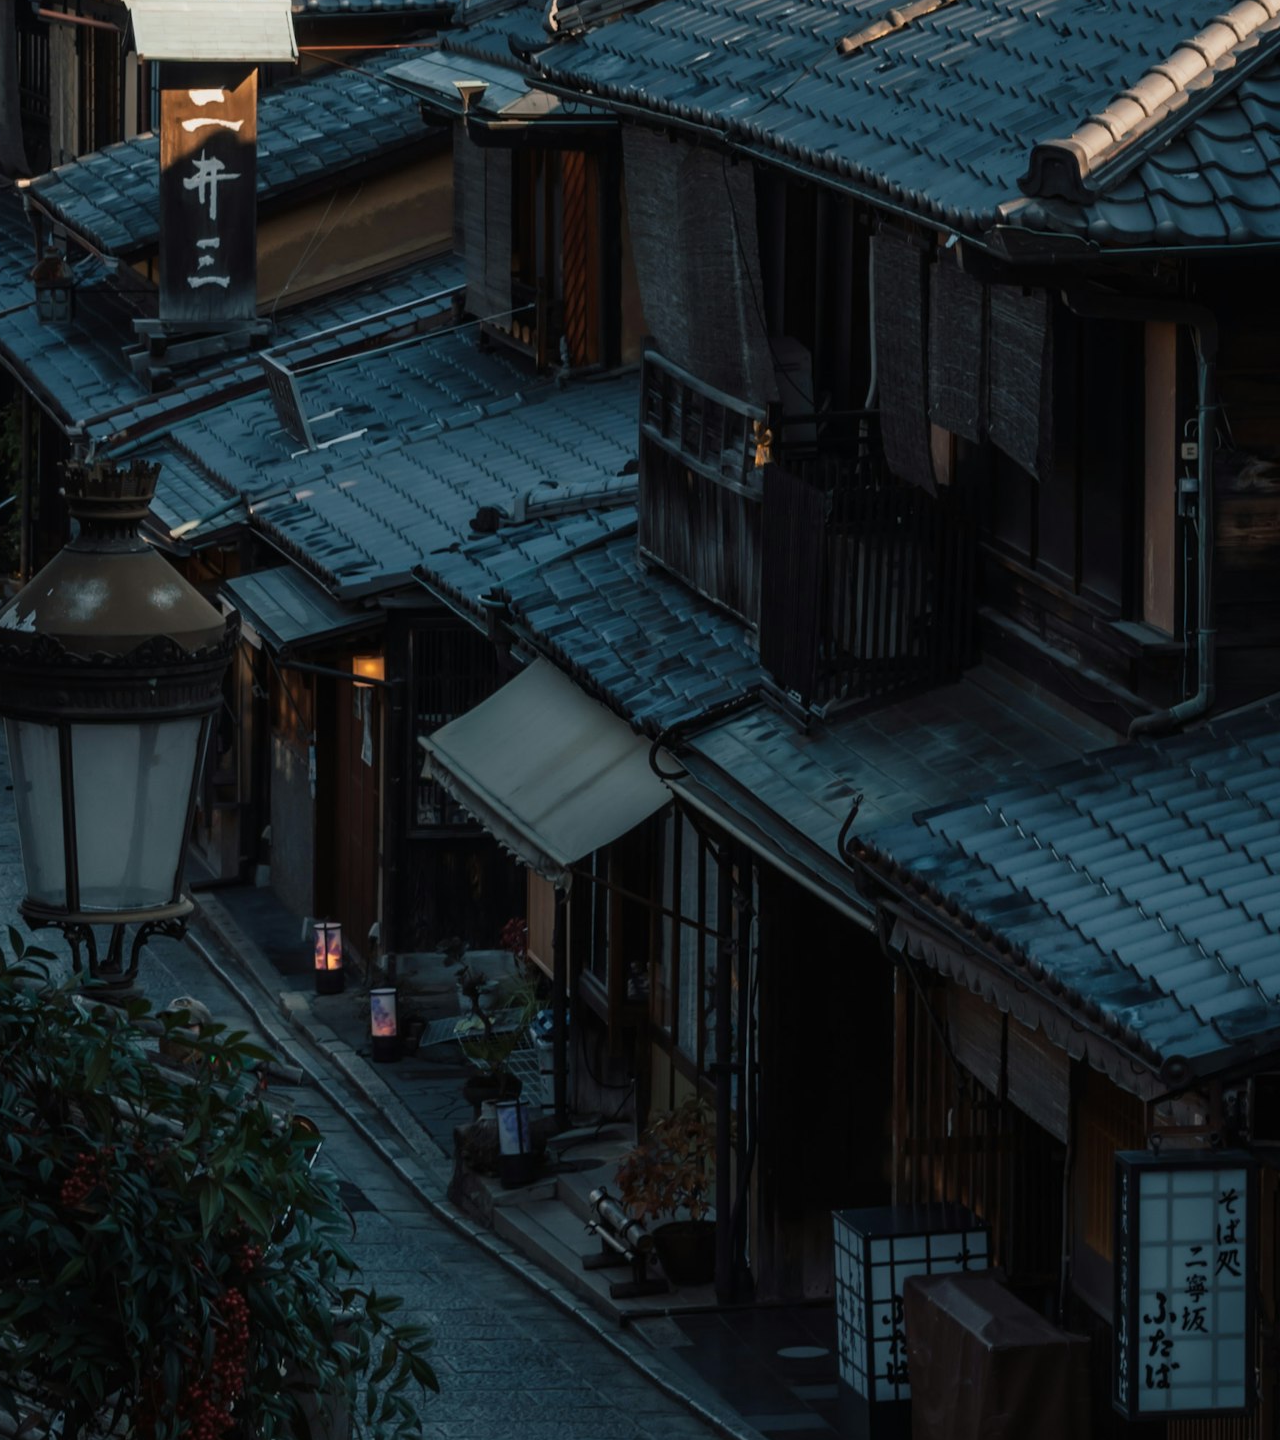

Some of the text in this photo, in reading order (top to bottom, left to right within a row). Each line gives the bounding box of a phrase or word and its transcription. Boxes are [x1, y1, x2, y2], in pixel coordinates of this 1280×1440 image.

[1215, 1188, 1241, 1277] そば処
[1182, 1247, 1208, 1333] 二寧坂
[1143, 1292, 1180, 1390] ふたば
